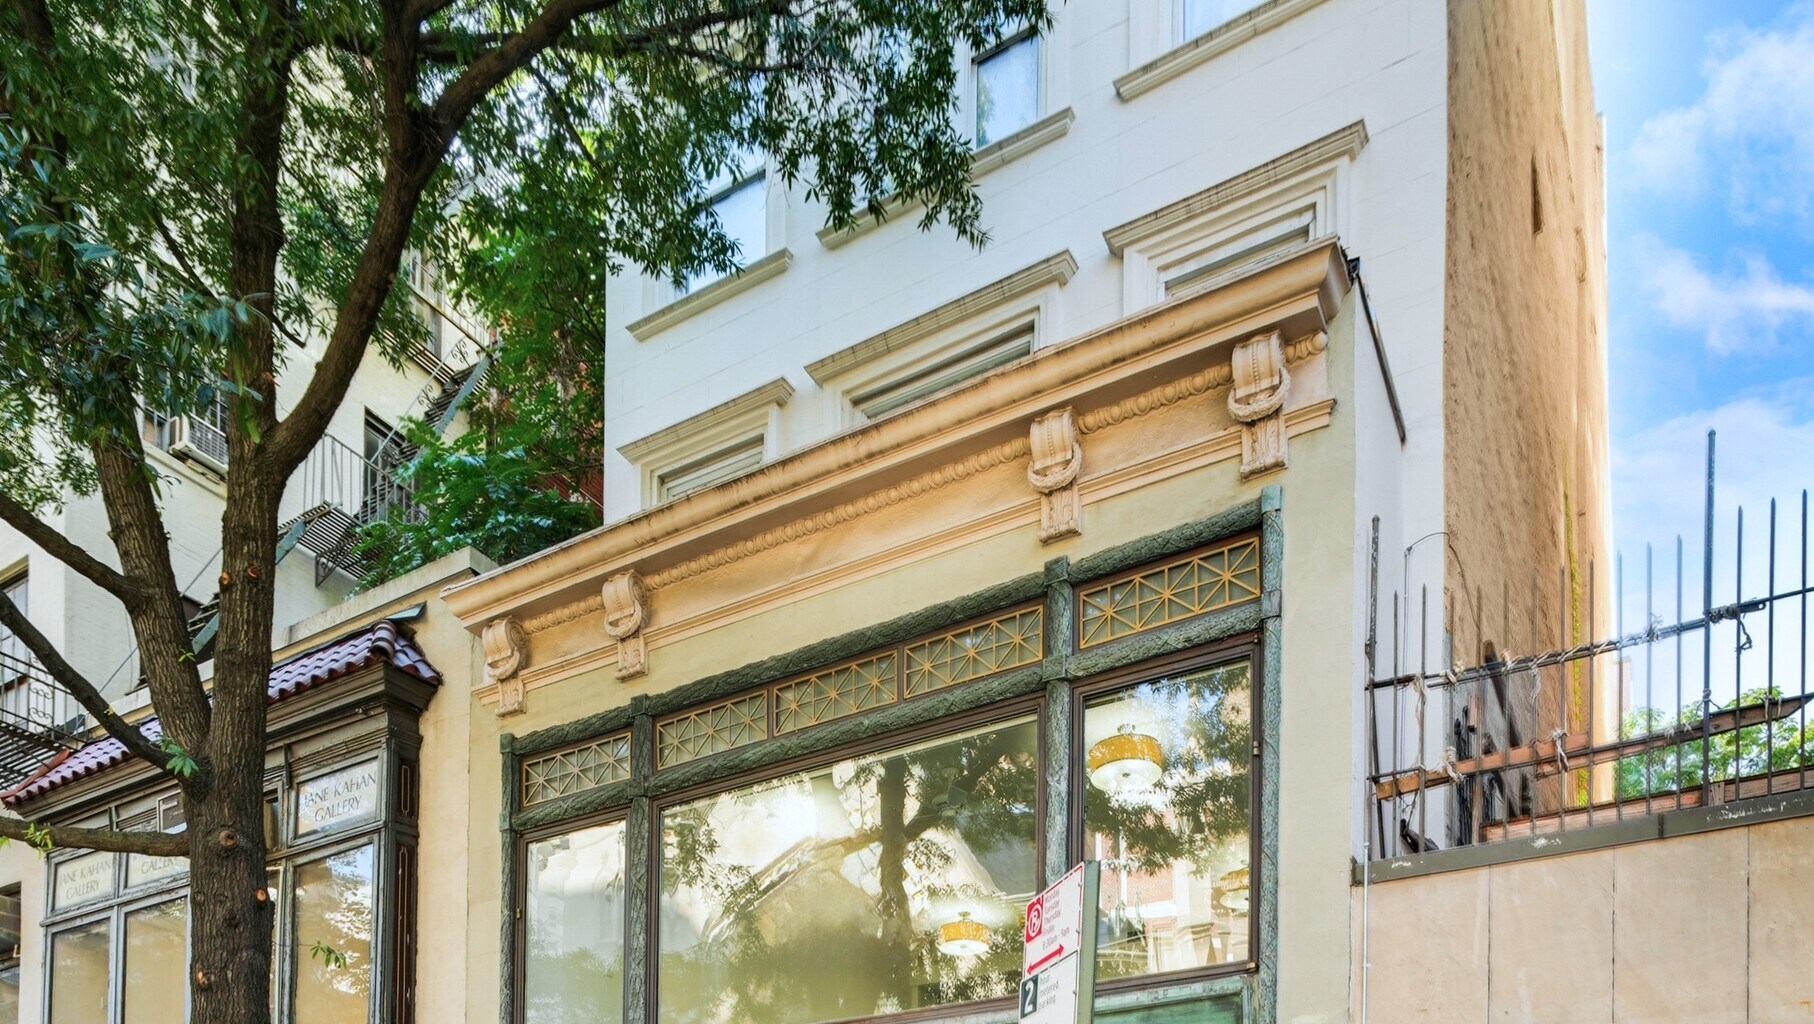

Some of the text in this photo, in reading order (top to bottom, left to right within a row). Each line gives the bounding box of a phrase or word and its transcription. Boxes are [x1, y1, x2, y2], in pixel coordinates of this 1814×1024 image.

[304, 771, 377, 807] JANE KAHAN
[315, 795, 362, 823] GALLERY
[80, 861, 111, 880] KAHAN
[66, 879, 100, 900] GALLERY
[1039, 980, 1059, 997] metered
[1040, 974, 1050, 985] hour
[1023, 980, 1034, 1015] 2
[1038, 995, 1056, 1011] parking
